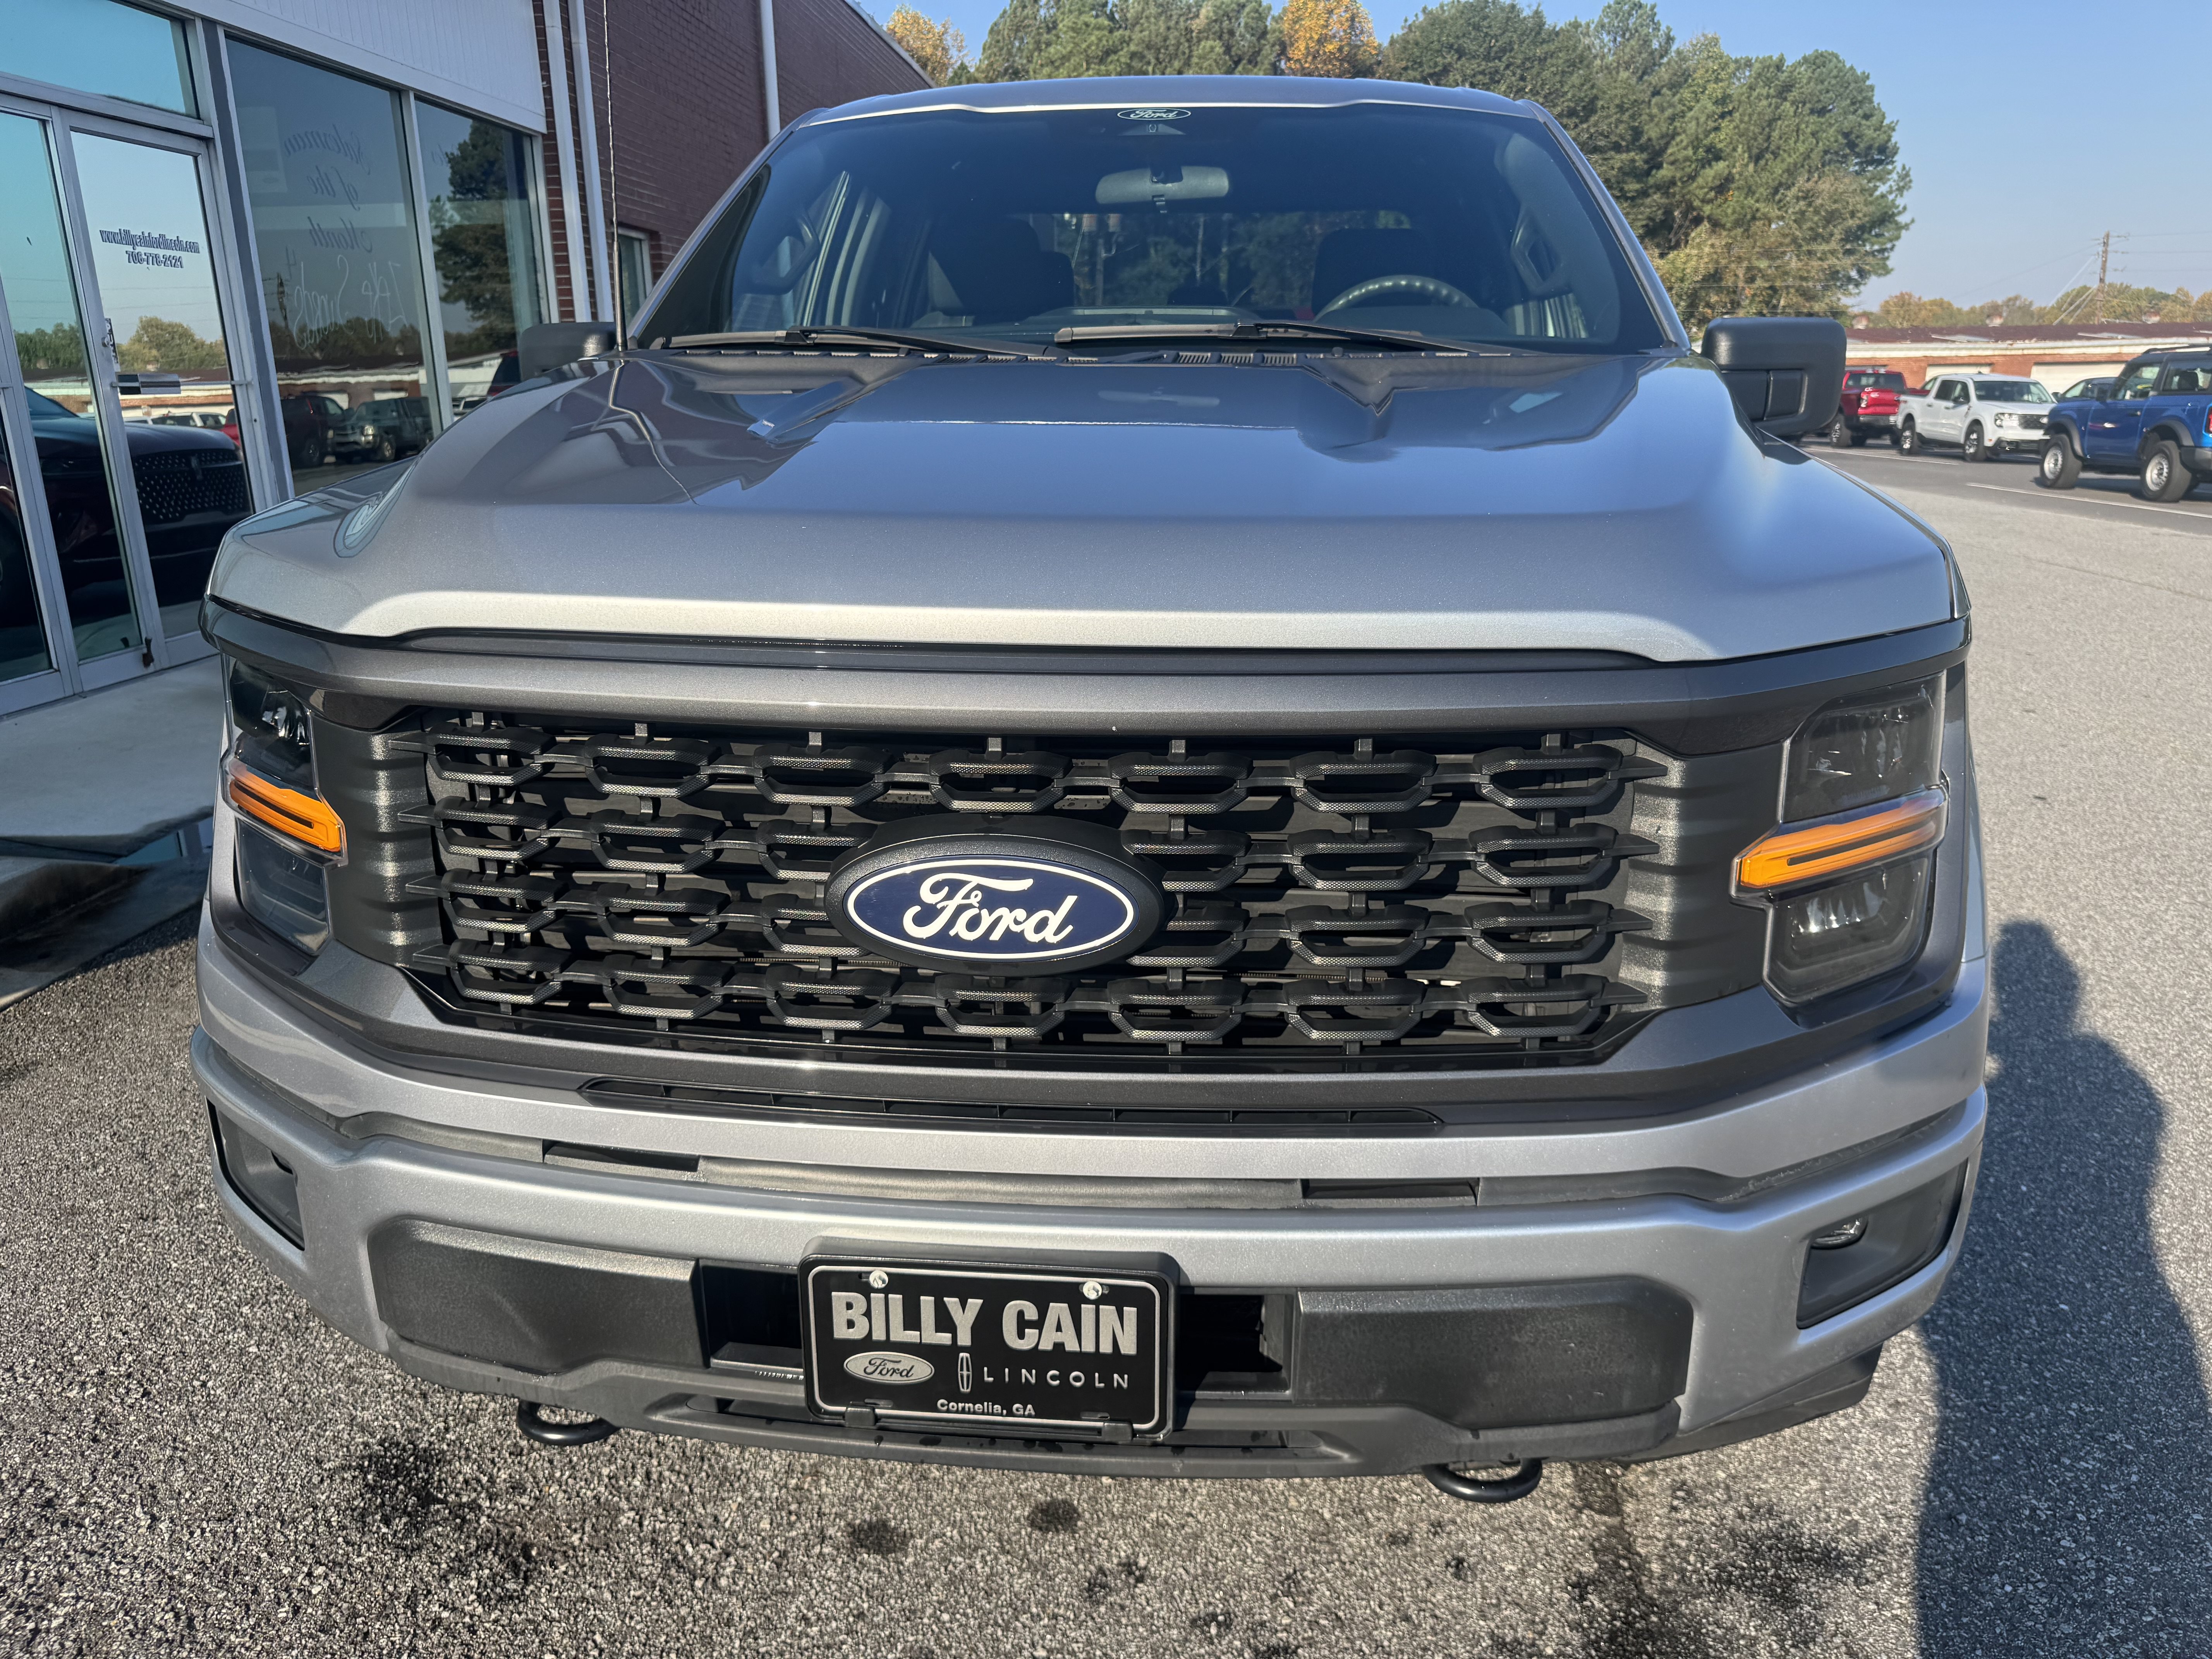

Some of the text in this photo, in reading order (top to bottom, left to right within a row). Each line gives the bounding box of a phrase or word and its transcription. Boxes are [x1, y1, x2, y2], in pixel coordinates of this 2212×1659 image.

[1130, 110, 1178, 118] Ford
[99, 228, 200, 253] www.billycainfordlincoln.com
[125, 251, 184, 268] 706-778-2121
[902, 872, 1078, 944] Ford
[831, 1291, 1138, 1356] BILLY CAIN
[863, 1357, 1129, 1389] Ford LINCOLN
[936, 1398, 1036, 1416] Cornelia, GA
